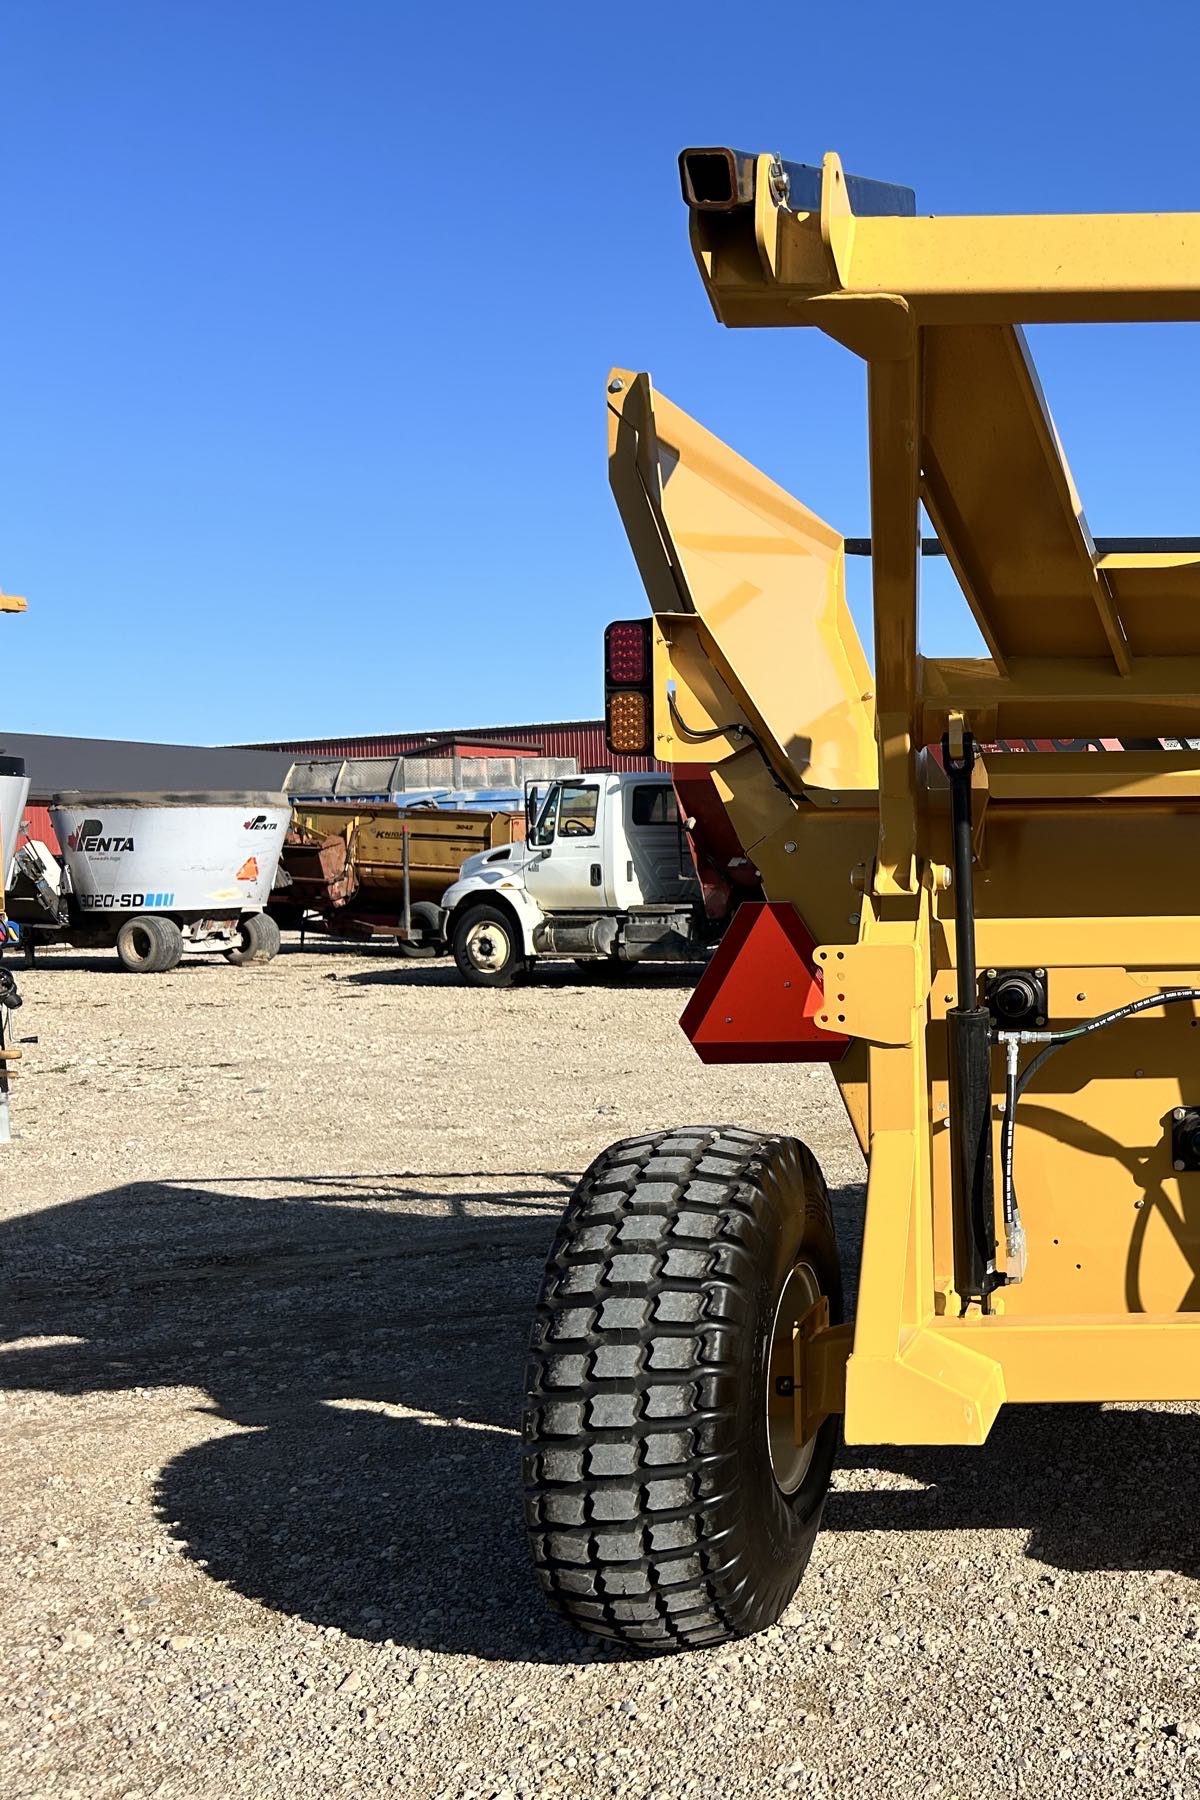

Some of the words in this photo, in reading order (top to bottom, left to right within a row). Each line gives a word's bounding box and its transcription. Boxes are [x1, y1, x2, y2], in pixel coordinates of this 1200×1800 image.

[250, 815, 278, 830] PENTA
[77, 819, 135, 851] PENTA
[81, 893, 145, 907] 3020-SD
